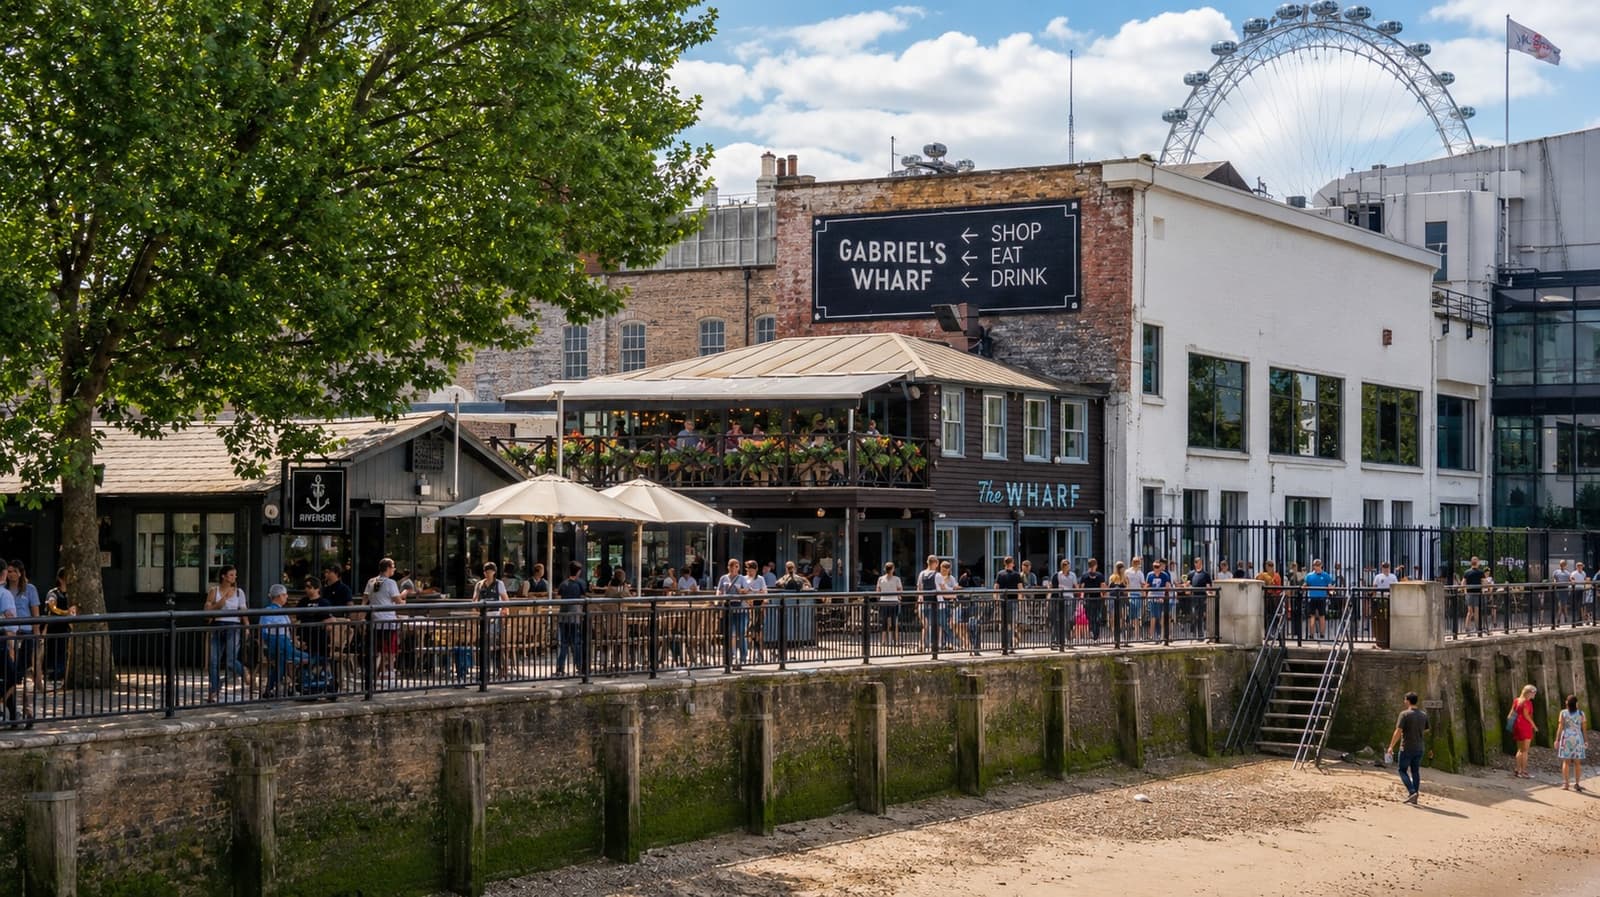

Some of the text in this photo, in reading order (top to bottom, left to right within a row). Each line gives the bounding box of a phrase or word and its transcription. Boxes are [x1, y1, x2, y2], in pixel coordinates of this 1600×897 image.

[991, 222, 1042, 243] SHOP
[839, 238, 947, 265] GABRIEL'S
[991, 246, 1023, 265] EAT
[851, 267, 933, 291] WHARF
[991, 267, 1048, 288] DRINK
[978, 480, 1081, 508] The WHARF
[299, 513, 337, 523] RIVERSIDE
